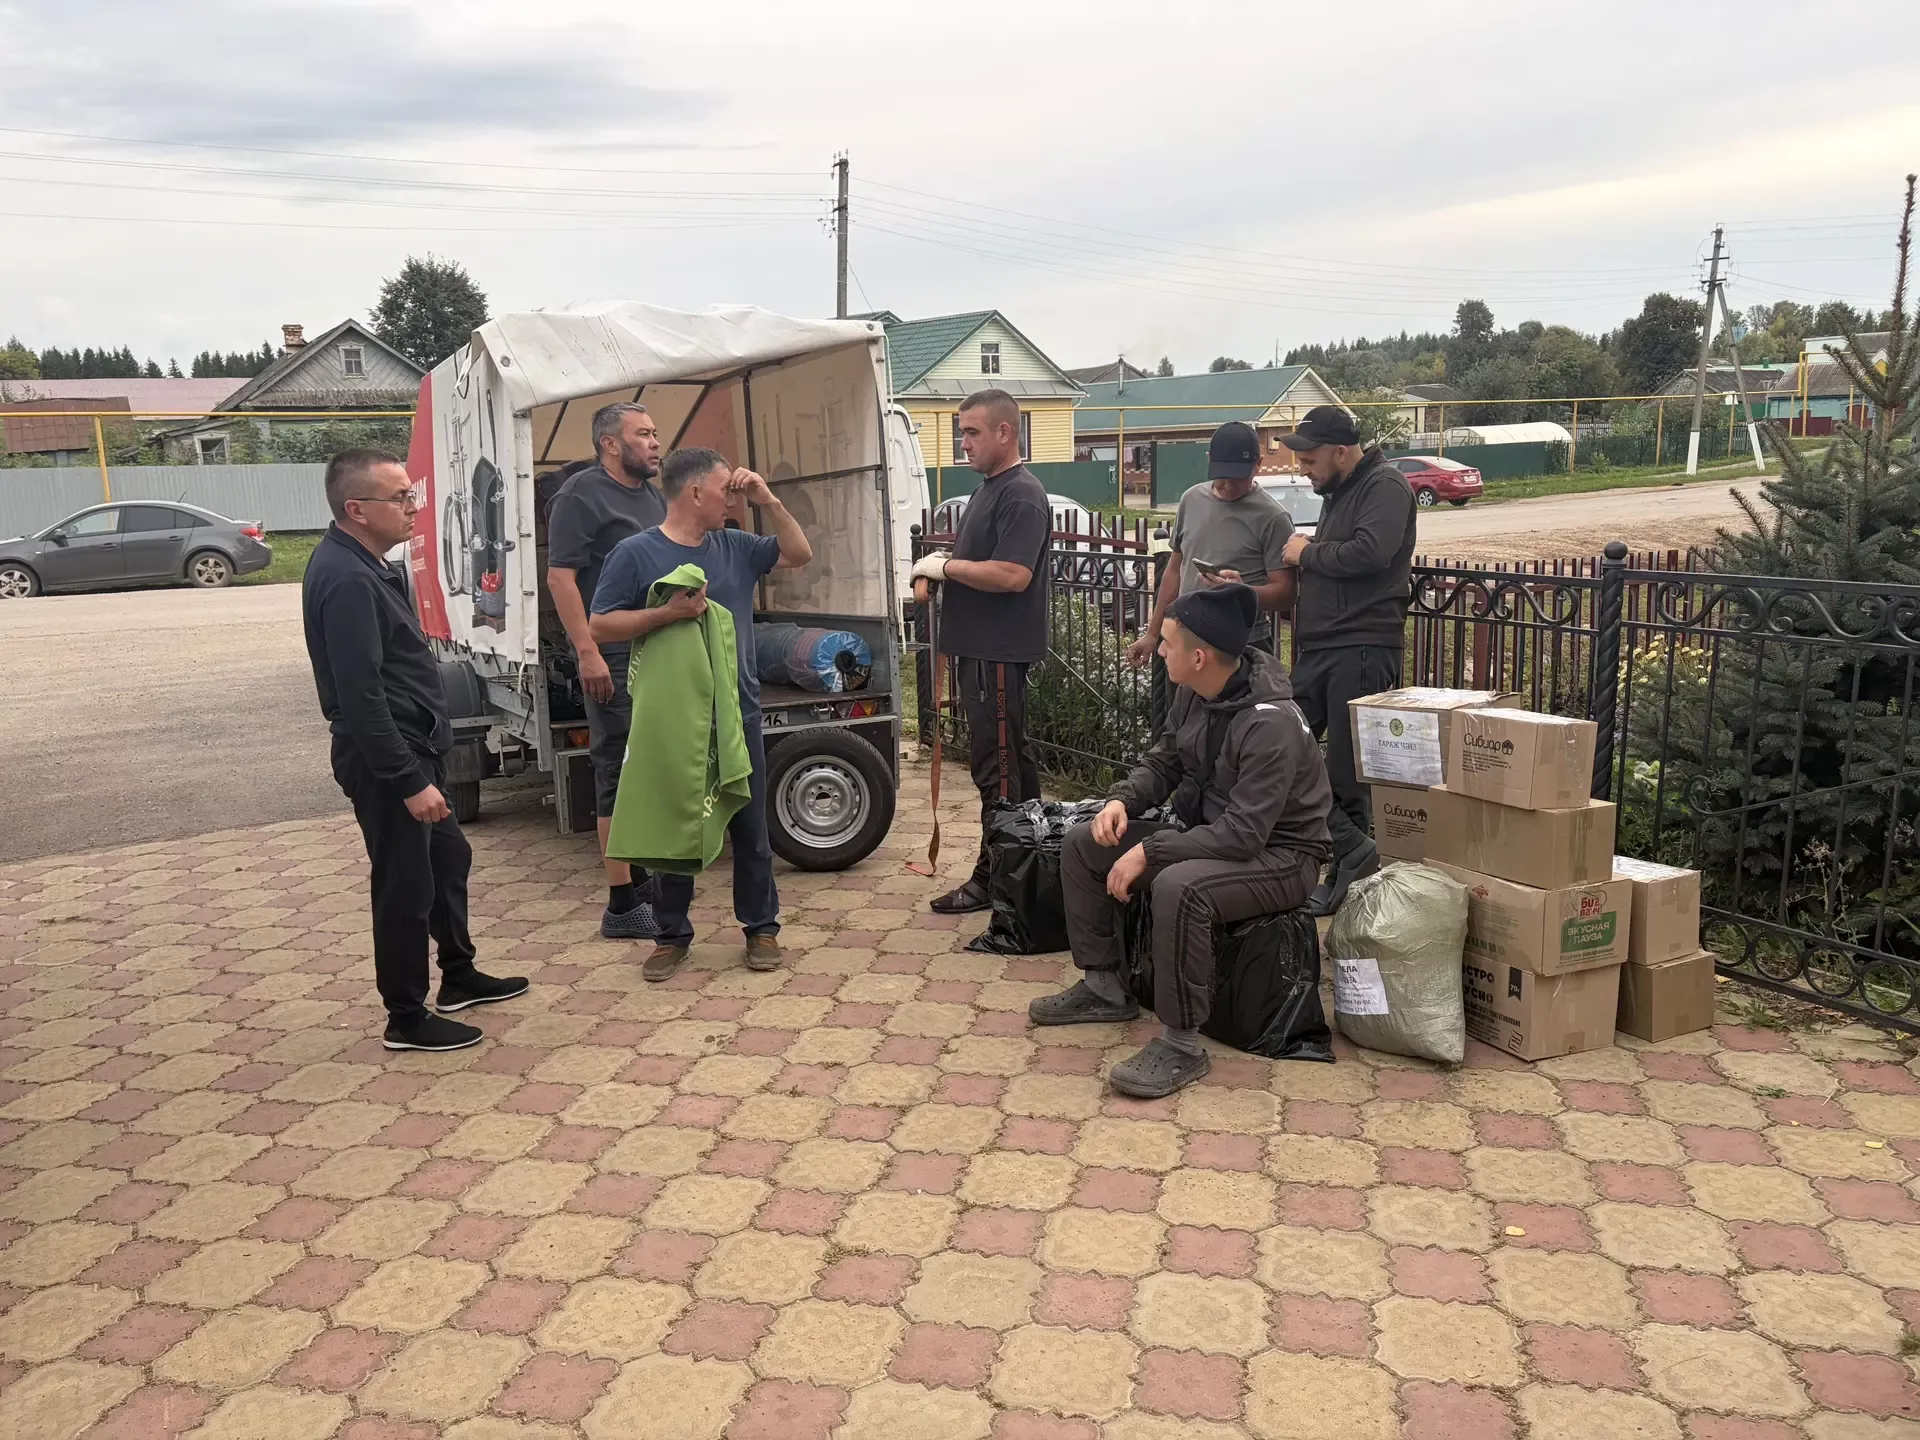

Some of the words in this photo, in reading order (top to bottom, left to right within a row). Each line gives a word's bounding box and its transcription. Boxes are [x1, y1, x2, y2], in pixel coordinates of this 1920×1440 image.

[764, 713, 783, 726] 16
[1568, 922, 1610, 936] ВКУСНАЯ
[1574, 932, 1603, 944] ПАУЗА
[1463, 985, 1494, 1004] УСНО
